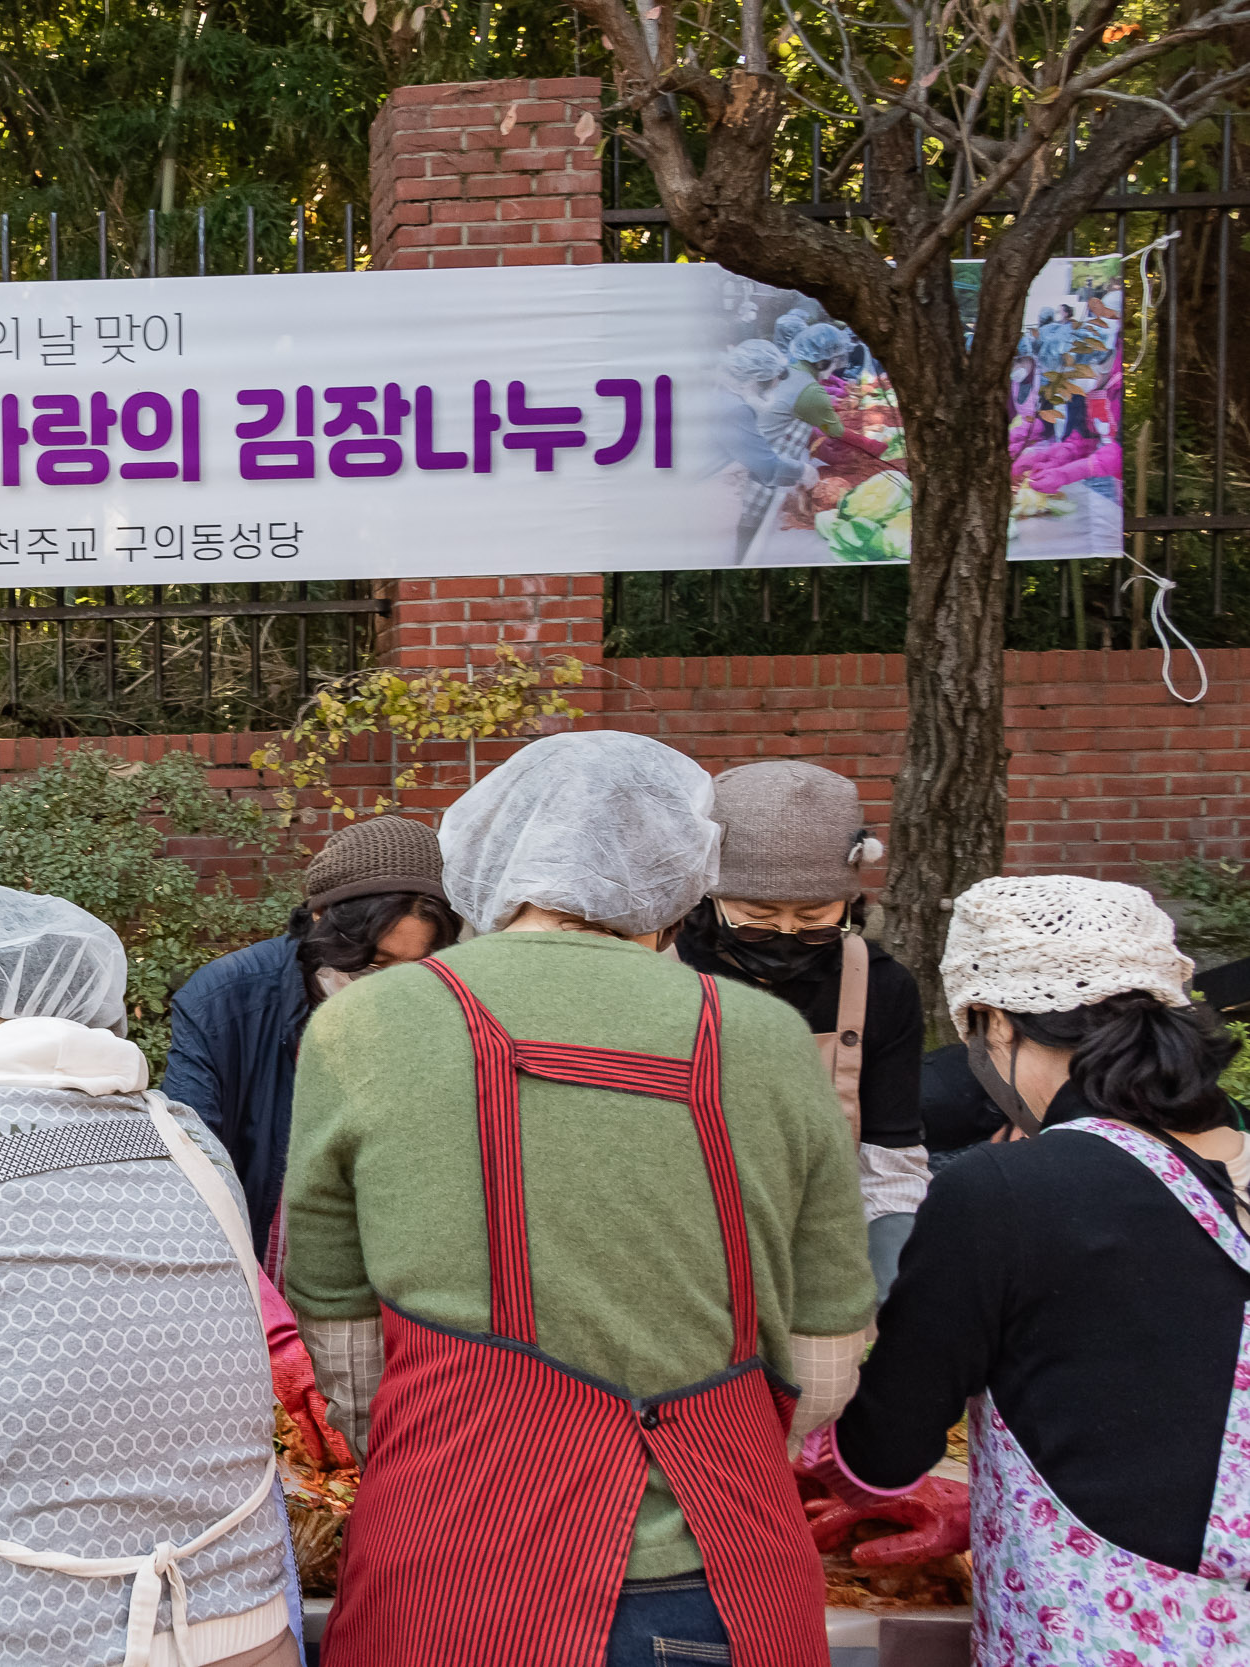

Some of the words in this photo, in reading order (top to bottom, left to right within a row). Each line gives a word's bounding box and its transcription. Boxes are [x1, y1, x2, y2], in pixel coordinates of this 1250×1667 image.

[38, 315, 83, 367] 날
[96, 312, 184, 365] 맞이
[236, 374, 673, 482] 김장나누기
[116, 523, 305, 564] 구의동성당
